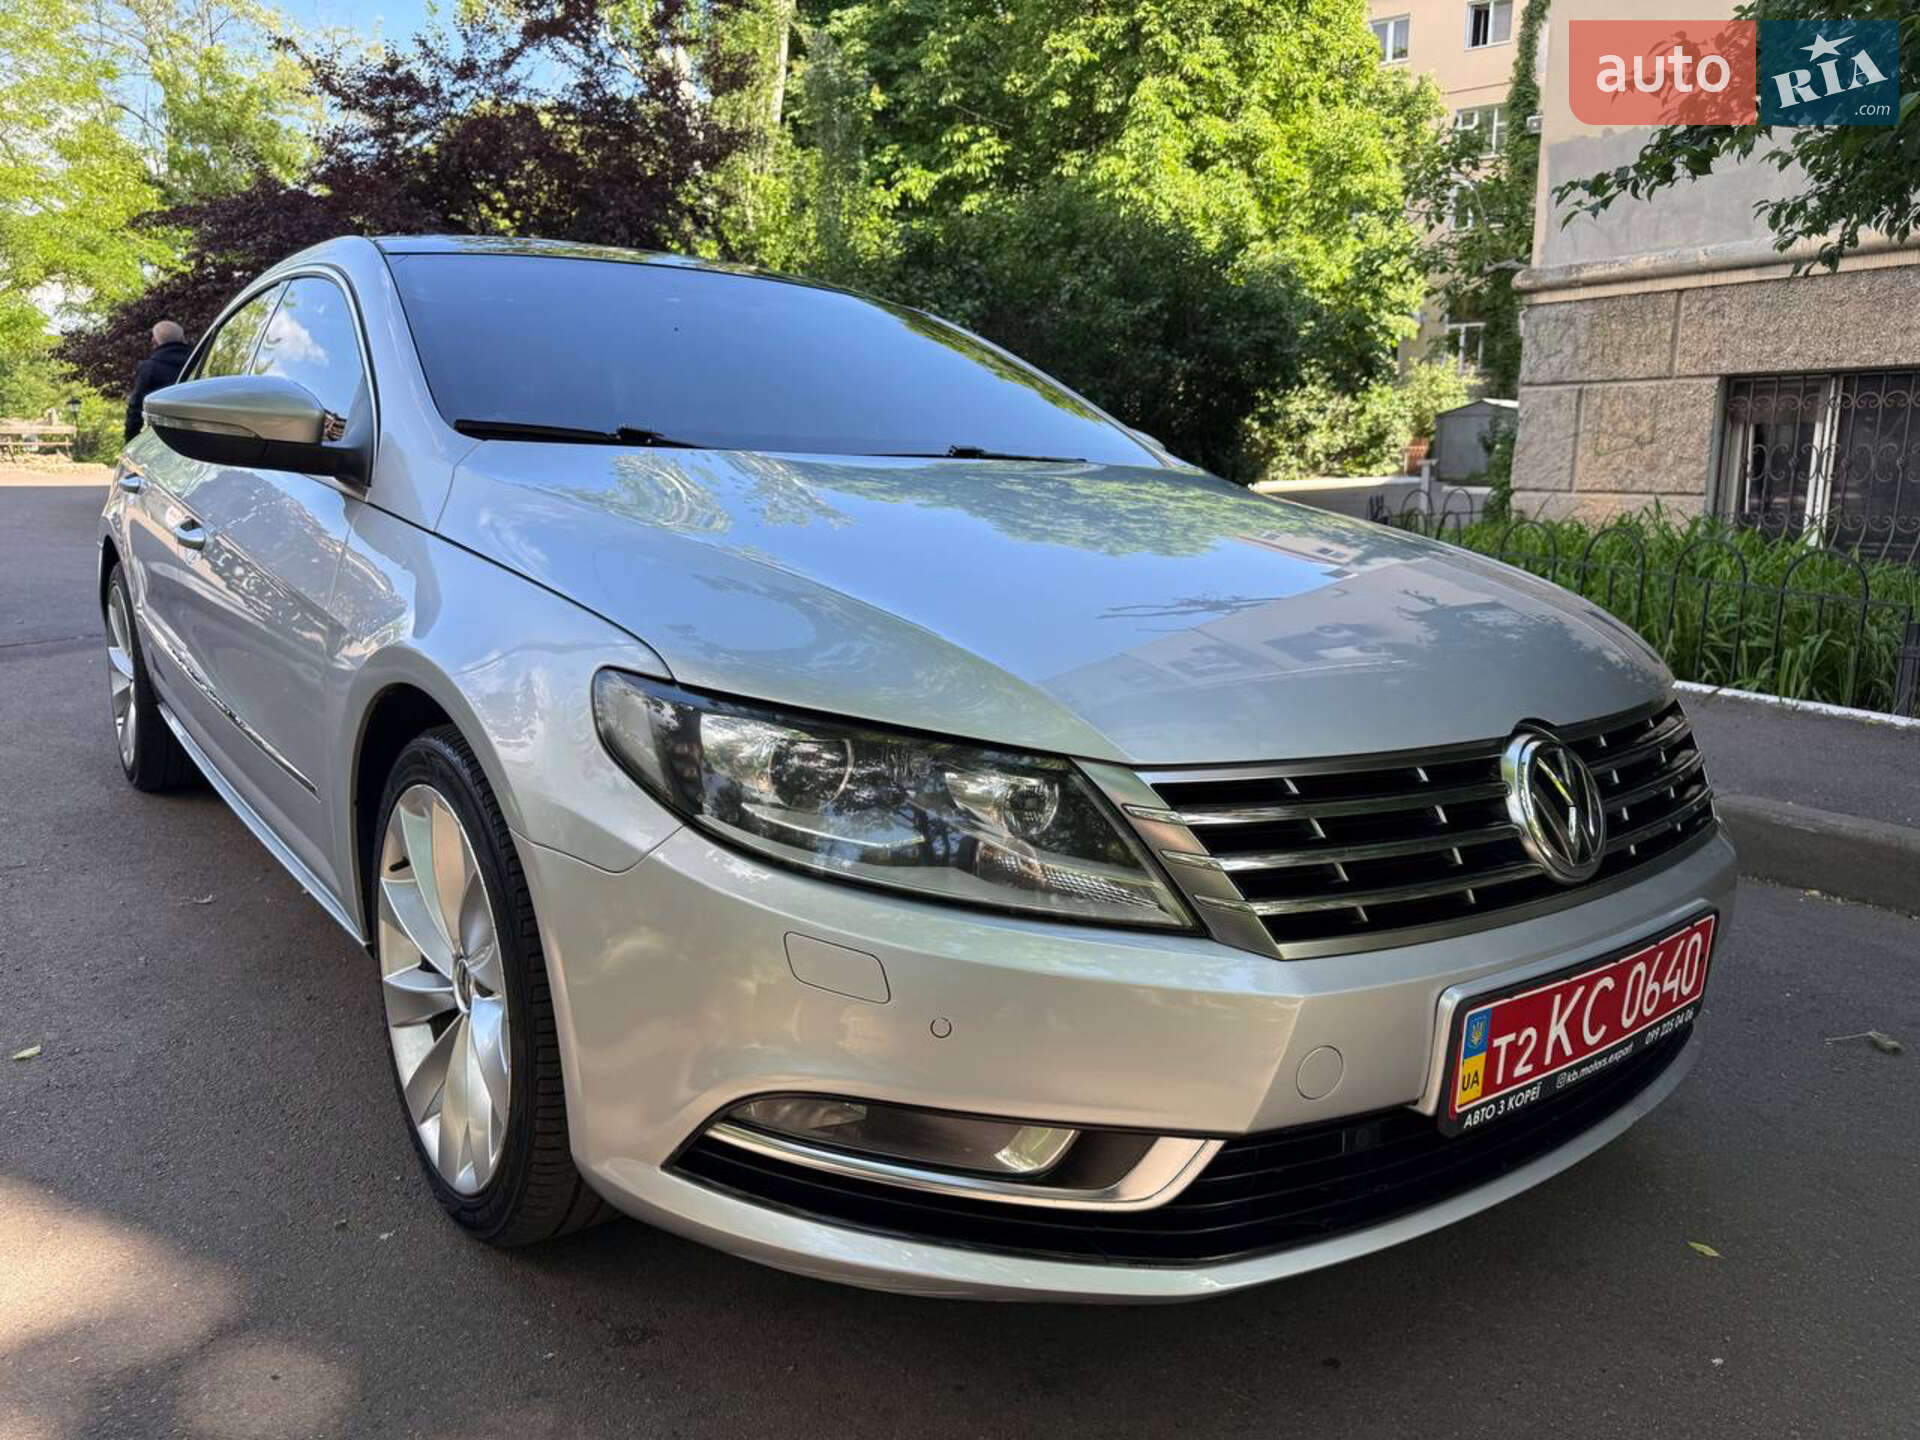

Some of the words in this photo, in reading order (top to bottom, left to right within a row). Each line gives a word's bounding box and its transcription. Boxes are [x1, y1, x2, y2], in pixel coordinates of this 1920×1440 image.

[1493, 1027, 1537, 1085] T2
[1544, 976, 1615, 1066] KC
[1621, 931, 1702, 1029] 0640
[1462, 1070, 1480, 1092] UA
[1463, 1104, 1496, 1129] АВТО
